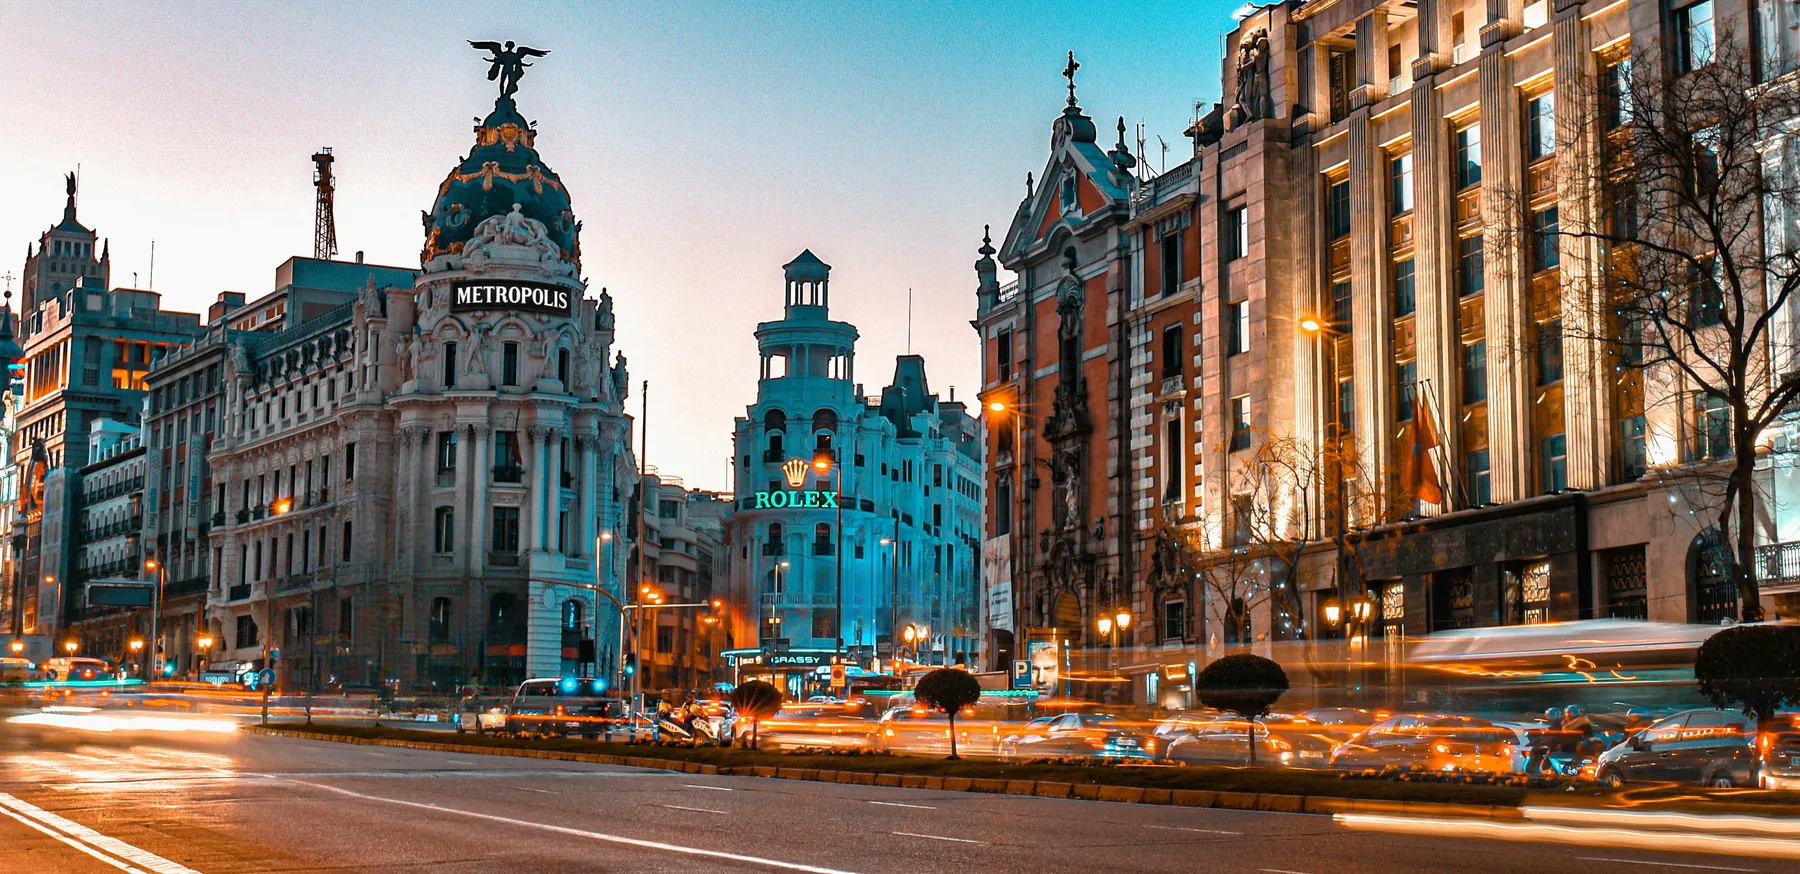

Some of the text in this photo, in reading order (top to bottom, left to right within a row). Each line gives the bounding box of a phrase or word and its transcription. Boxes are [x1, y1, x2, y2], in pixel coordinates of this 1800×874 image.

[457, 286, 568, 309] METROPOLIS
[755, 490, 839, 509] ROLEX
[771, 656, 820, 664] GRASSY
[1015, 661, 1028, 679] P
